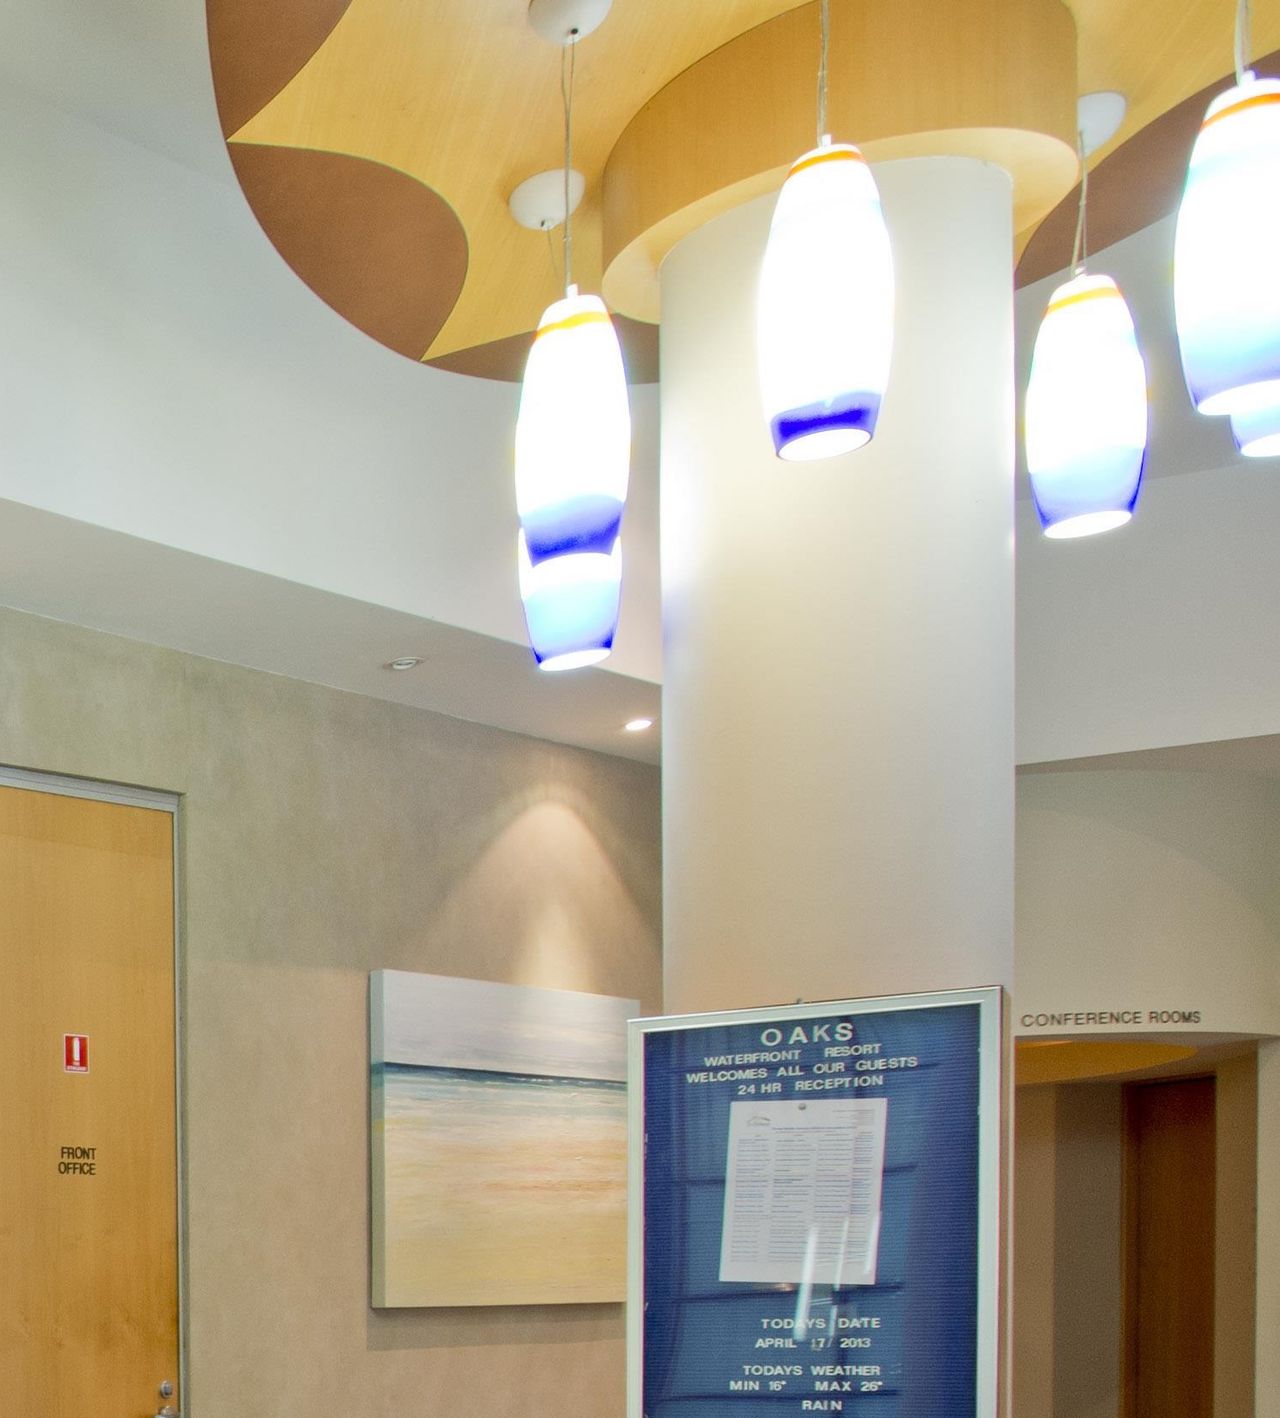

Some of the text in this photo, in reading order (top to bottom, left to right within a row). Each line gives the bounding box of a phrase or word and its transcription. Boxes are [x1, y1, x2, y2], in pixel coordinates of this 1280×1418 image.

[1021, 1010, 1201, 1027] CONFERENCE ROOMS
[760, 1022, 854, 1046] OAKS
[704, 1043, 882, 1067] WATERFRONT RESORT
[686, 1056, 918, 1084] WELCOMES ALL OUR GUESTS
[737, 1075, 884, 1095] 24 HR RECEPTION
[61, 1146, 97, 1160] FRONT
[58, 1161, 96, 1175] OFFICE
[761, 1317, 881, 1329] TODAYS DATE
[755, 1338, 797, 1348] APRIL
[840, 1337, 871, 1348] 2013
[743, 1365, 881, 1376] TODAYS WEATHER
[729, 1380, 759, 1391] MIN
[814, 1381, 852, 1391] MAX
[801, 1400, 843, 1411] RAIN
